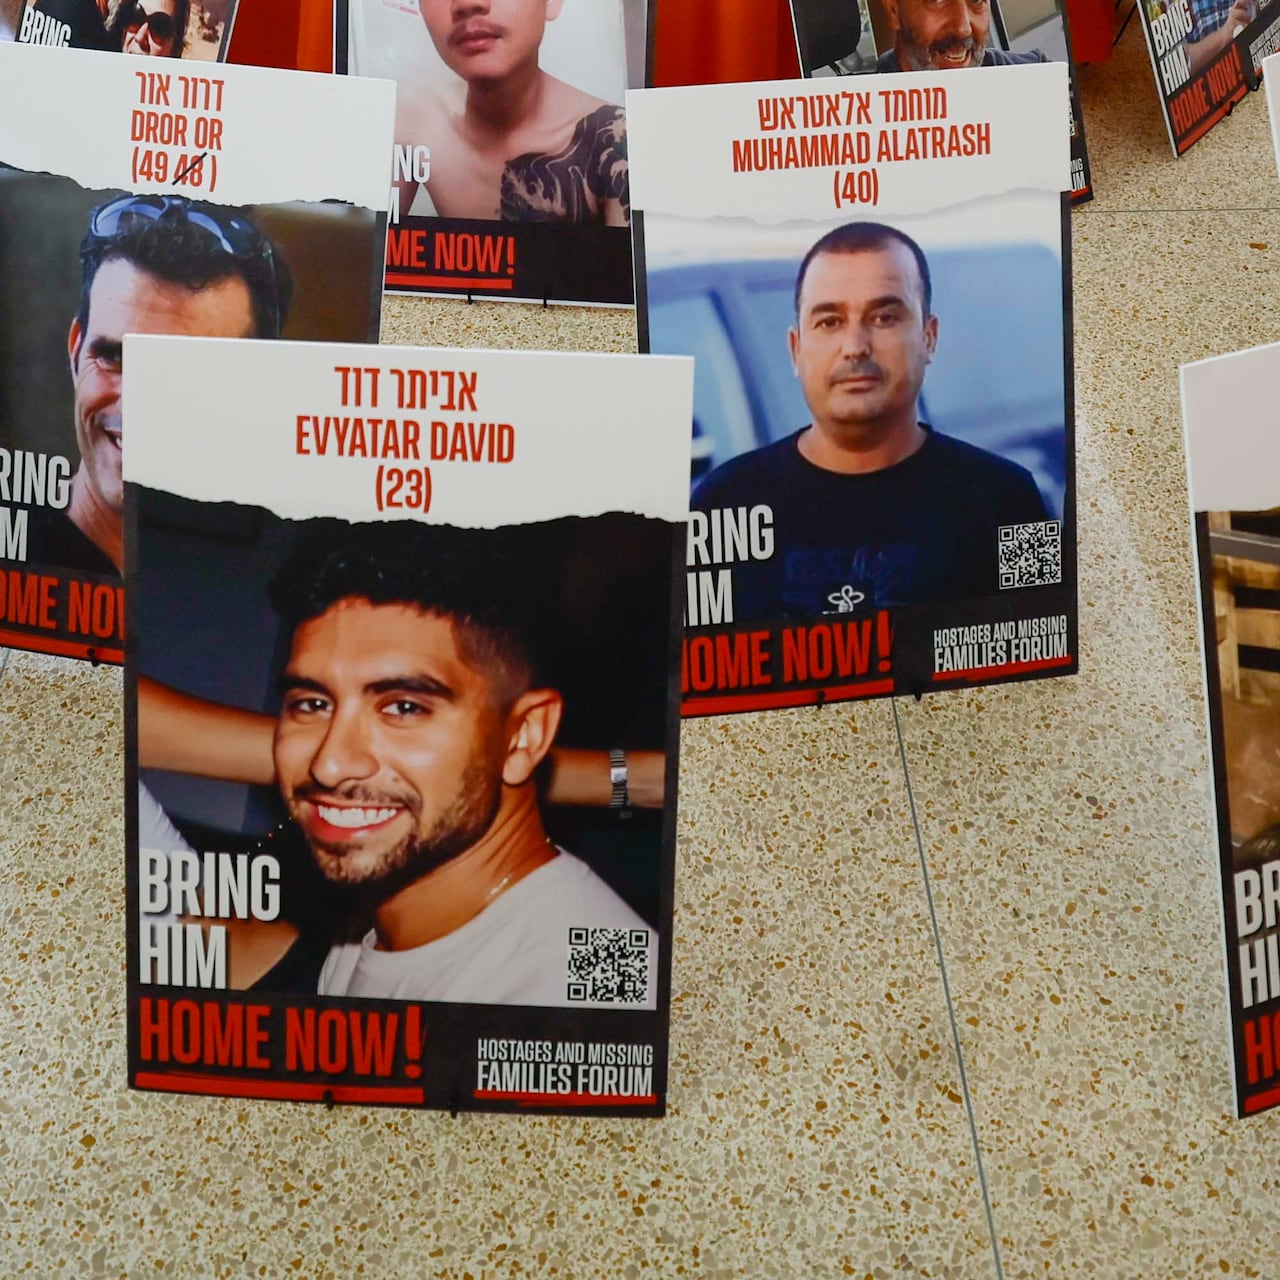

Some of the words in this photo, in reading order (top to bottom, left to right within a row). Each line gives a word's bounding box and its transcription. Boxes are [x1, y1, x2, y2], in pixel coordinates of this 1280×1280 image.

[135, 71, 171, 106] אור
[1160, 44, 1191, 97] HIM
[1169, 77, 1210, 137] HOME
[1206, 42, 1245, 106] NOW!
[178, 75, 225, 112] דרור
[758, 90, 873, 132] אלאטראש
[878, 86, 948, 124] מוחמד
[131, 109, 188, 147] DROR
[194, 116, 224, 151] OR
[732, 131, 871, 173] MUHAMMAD
[876, 122, 992, 163] ALATRASH
[833, 167, 880, 209] (40)
[387, 228, 427, 269] ME
[434, 232, 517, 276] NOW!
[334, 366, 381, 408] דוד
[390, 367, 479, 412] אביתר
[296, 415, 421, 460] EVYATAR
[430, 421, 515, 464] DAVID
[376, 464, 433, 514] (23)
[686, 504, 775, 566] RING
[782, 610, 893, 684] NOW!
[933, 623, 991, 649] HOSTAGES
[993, 620, 1016, 641] AND
[1018, 614, 1068, 638] MISSING
[934, 640, 1007, 674] FAMILIES
[1011, 632, 1068, 664] FORUM
[138, 848, 281, 922] BRING
[139, 922, 227, 990] HIM
[140, 997, 271, 1069] HOME
[285, 1005, 423, 1079] NOW!
[477, 1037, 552, 1062] HOSTAGES
[554, 1041, 585, 1064] AND
[588, 1043, 653, 1067] MISSING
[477, 1061, 572, 1095] FAMILIES
[577, 1064, 653, 1097] FORUM
